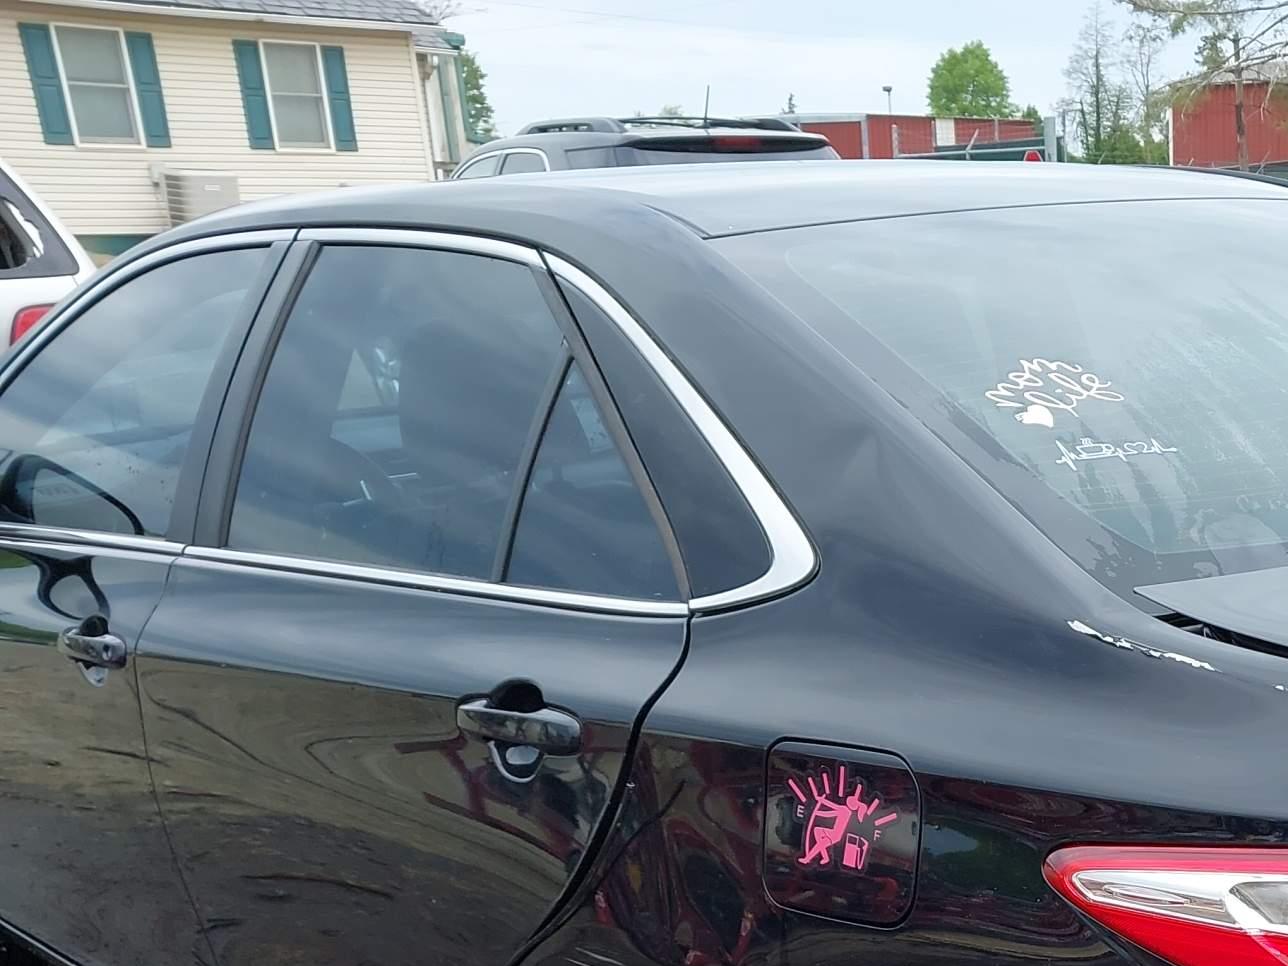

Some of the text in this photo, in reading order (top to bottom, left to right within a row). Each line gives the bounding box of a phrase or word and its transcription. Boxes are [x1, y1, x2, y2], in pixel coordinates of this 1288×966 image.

[1023, 373, 1125, 418] life
[796, 805, 805, 818] E
[873, 830, 882, 841] F
